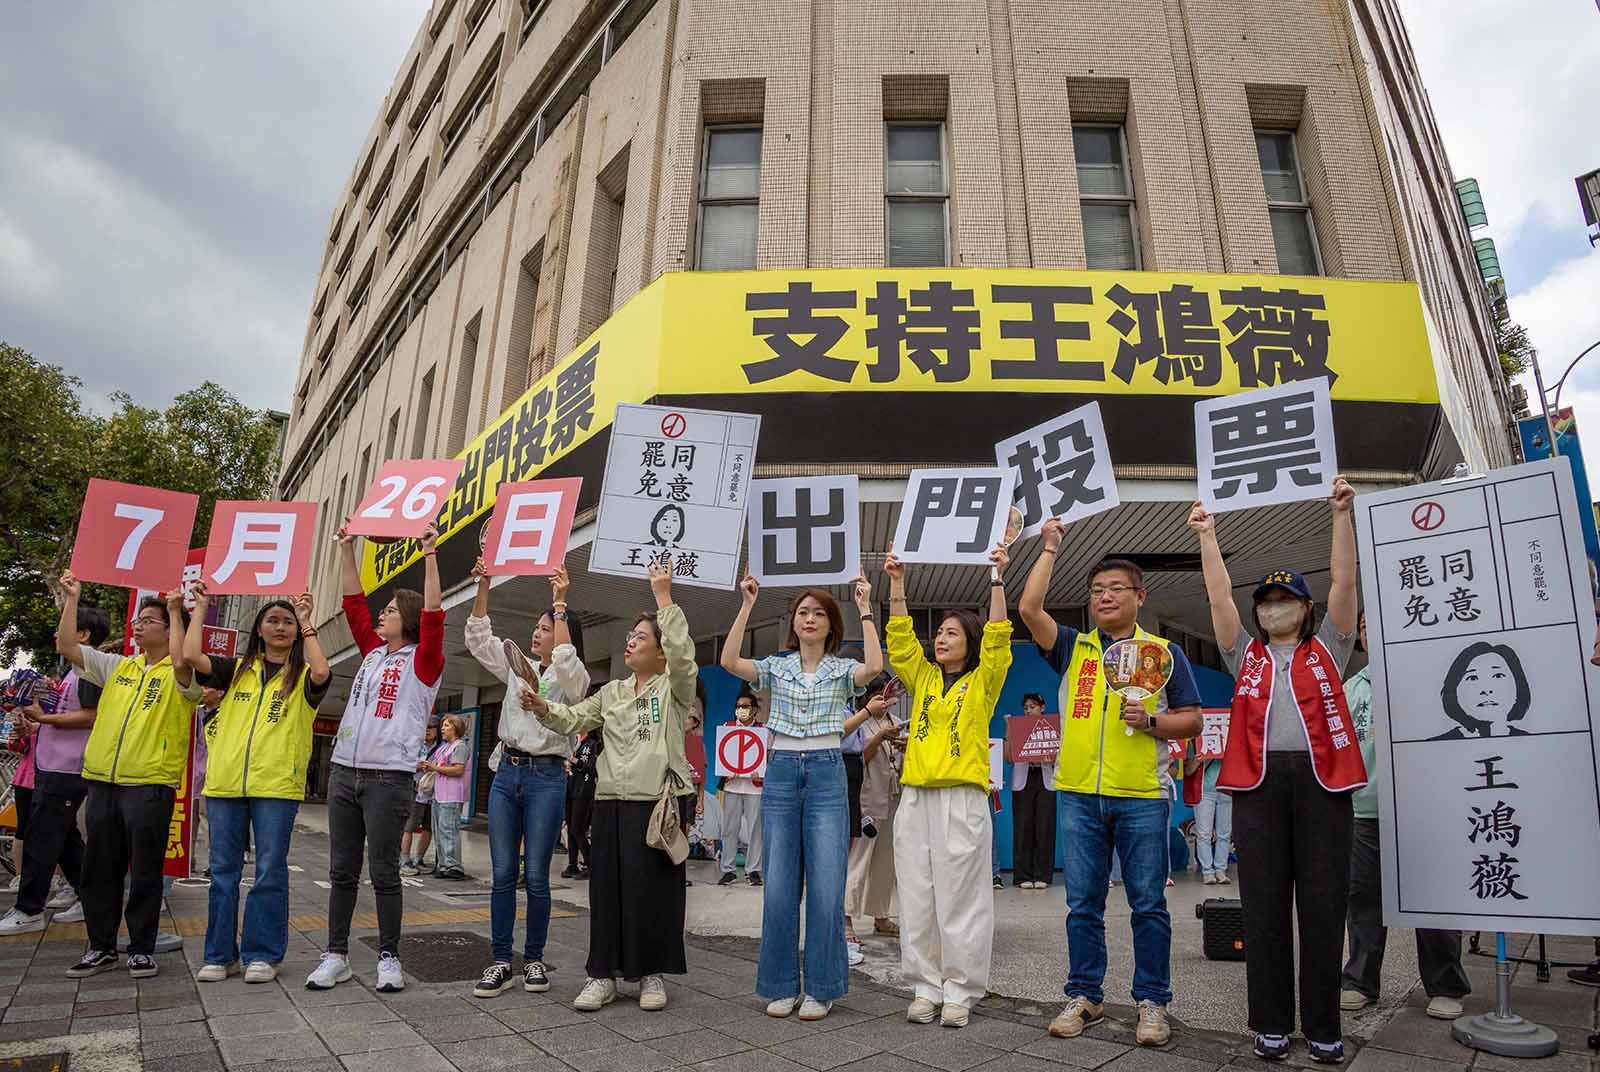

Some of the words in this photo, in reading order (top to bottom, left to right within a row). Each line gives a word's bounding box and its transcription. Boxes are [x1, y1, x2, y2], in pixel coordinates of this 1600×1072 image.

[741, 281, 1336, 387] 支持王鴻薇
[727, 453, 744, 502] 不同意罷免
[1008, 418, 1105, 527] 投
[1208, 391, 1323, 500] 票
[360, 475, 447, 520] 26
[494, 491, 564, 566] 日
[761, 488, 846, 576] 出
[904, 477, 1003, 554] 門
[114, 503, 165, 571] 7
[210, 512, 297, 587] 月
[620, 547, 700, 579] 王鴻薇
[1527, 539, 1549, 602] 不同意罷免
[374, 667, 402, 720] 林延鳳
[1463, 755, 1529, 901] 王鴻薇
